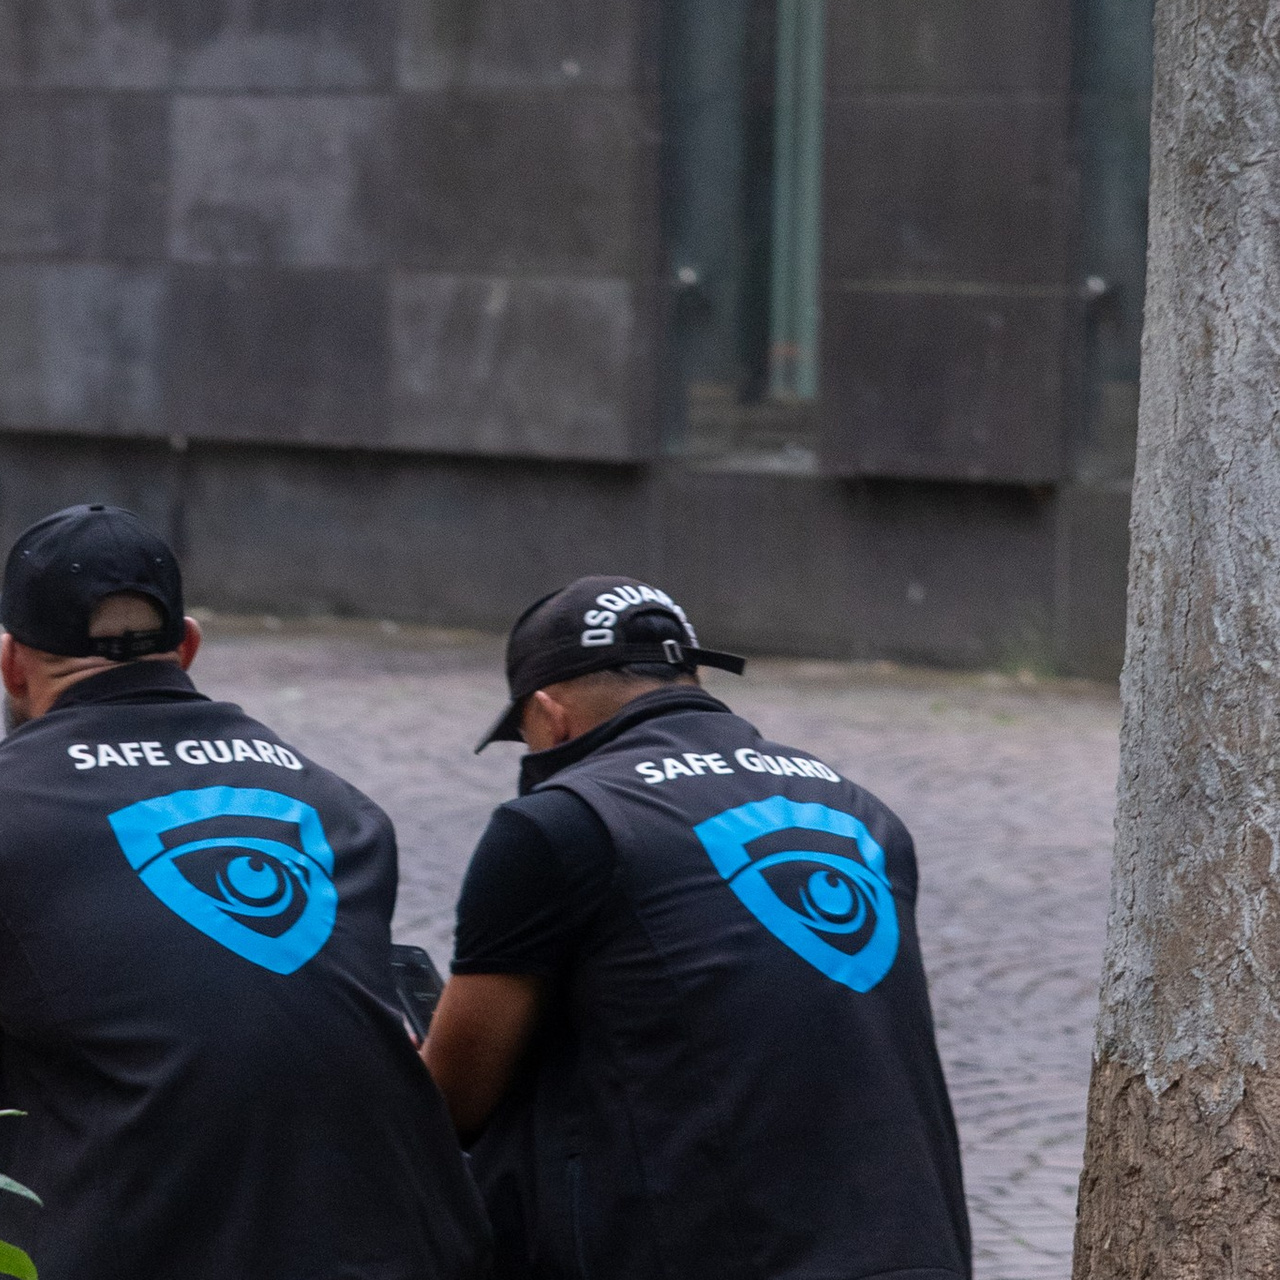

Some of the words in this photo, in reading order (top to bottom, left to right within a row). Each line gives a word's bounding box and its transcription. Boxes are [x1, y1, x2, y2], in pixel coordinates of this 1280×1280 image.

[581, 585, 700, 648] DSQUA
[67, 742, 171, 770] SAFE
[175, 739, 303, 770] GUARD
[635, 753, 735, 784] SAFE
[734, 748, 841, 783] GUARD
